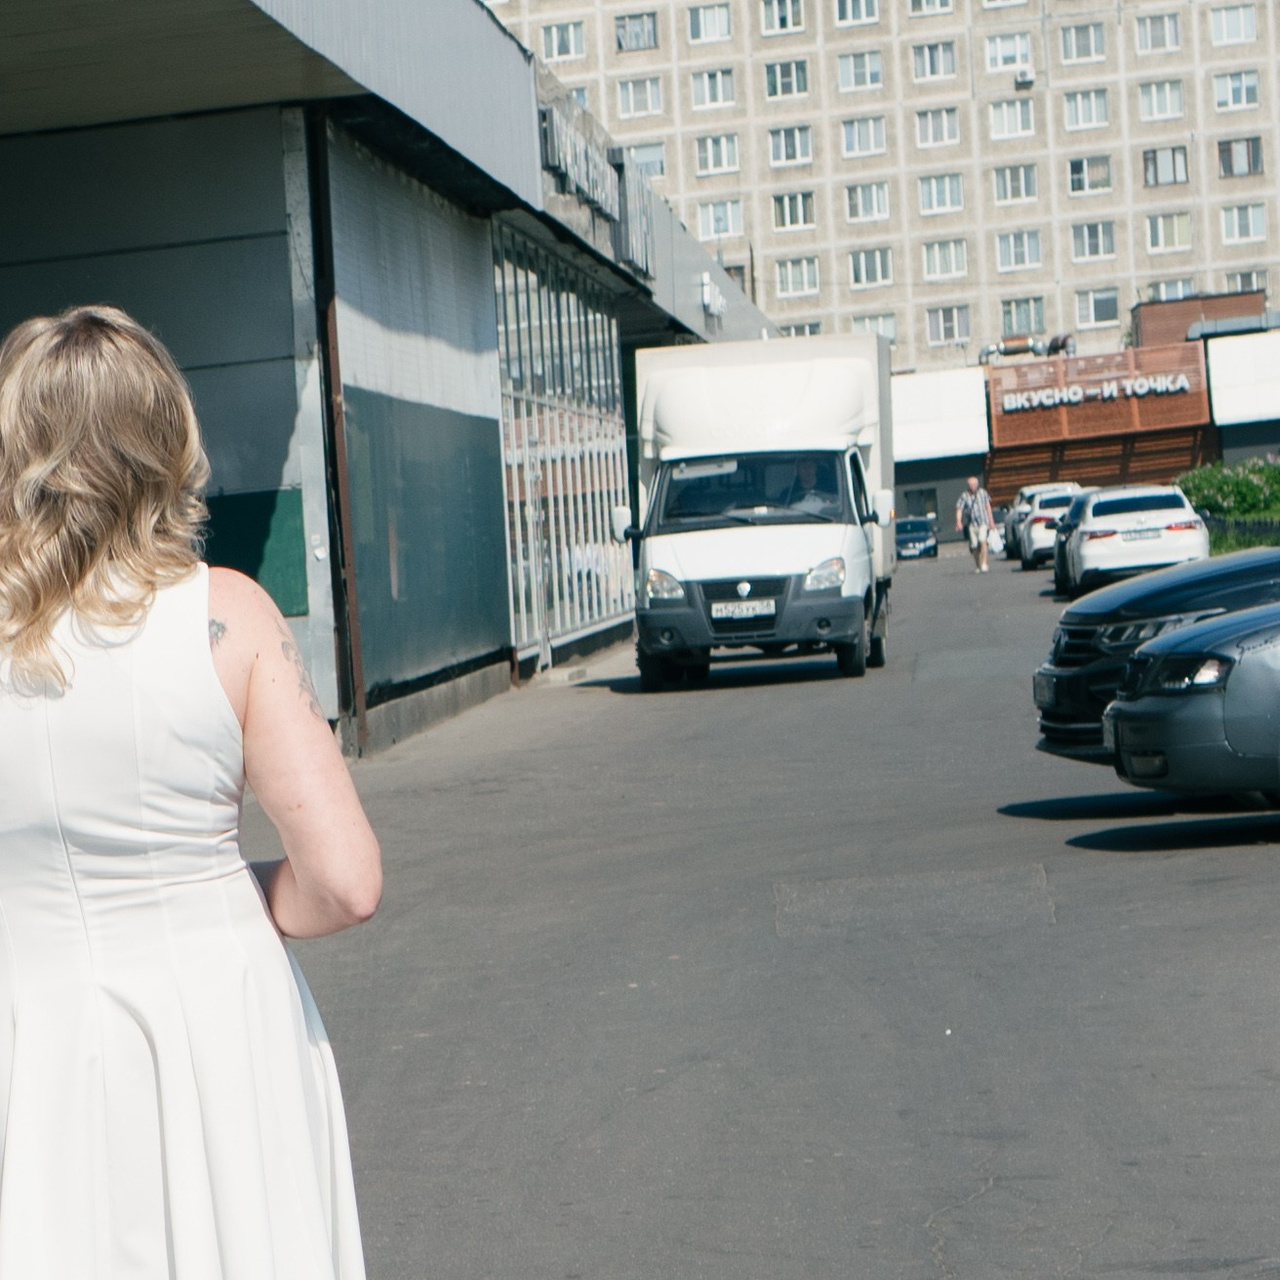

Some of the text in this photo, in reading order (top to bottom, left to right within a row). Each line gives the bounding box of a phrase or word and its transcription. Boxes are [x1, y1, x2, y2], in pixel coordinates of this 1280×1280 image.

[1003, 385, 1083, 412] ВКУСНО
[1102, 381, 1117, 399] И
[1122, 374, 1190, 397] ТОЧКА
